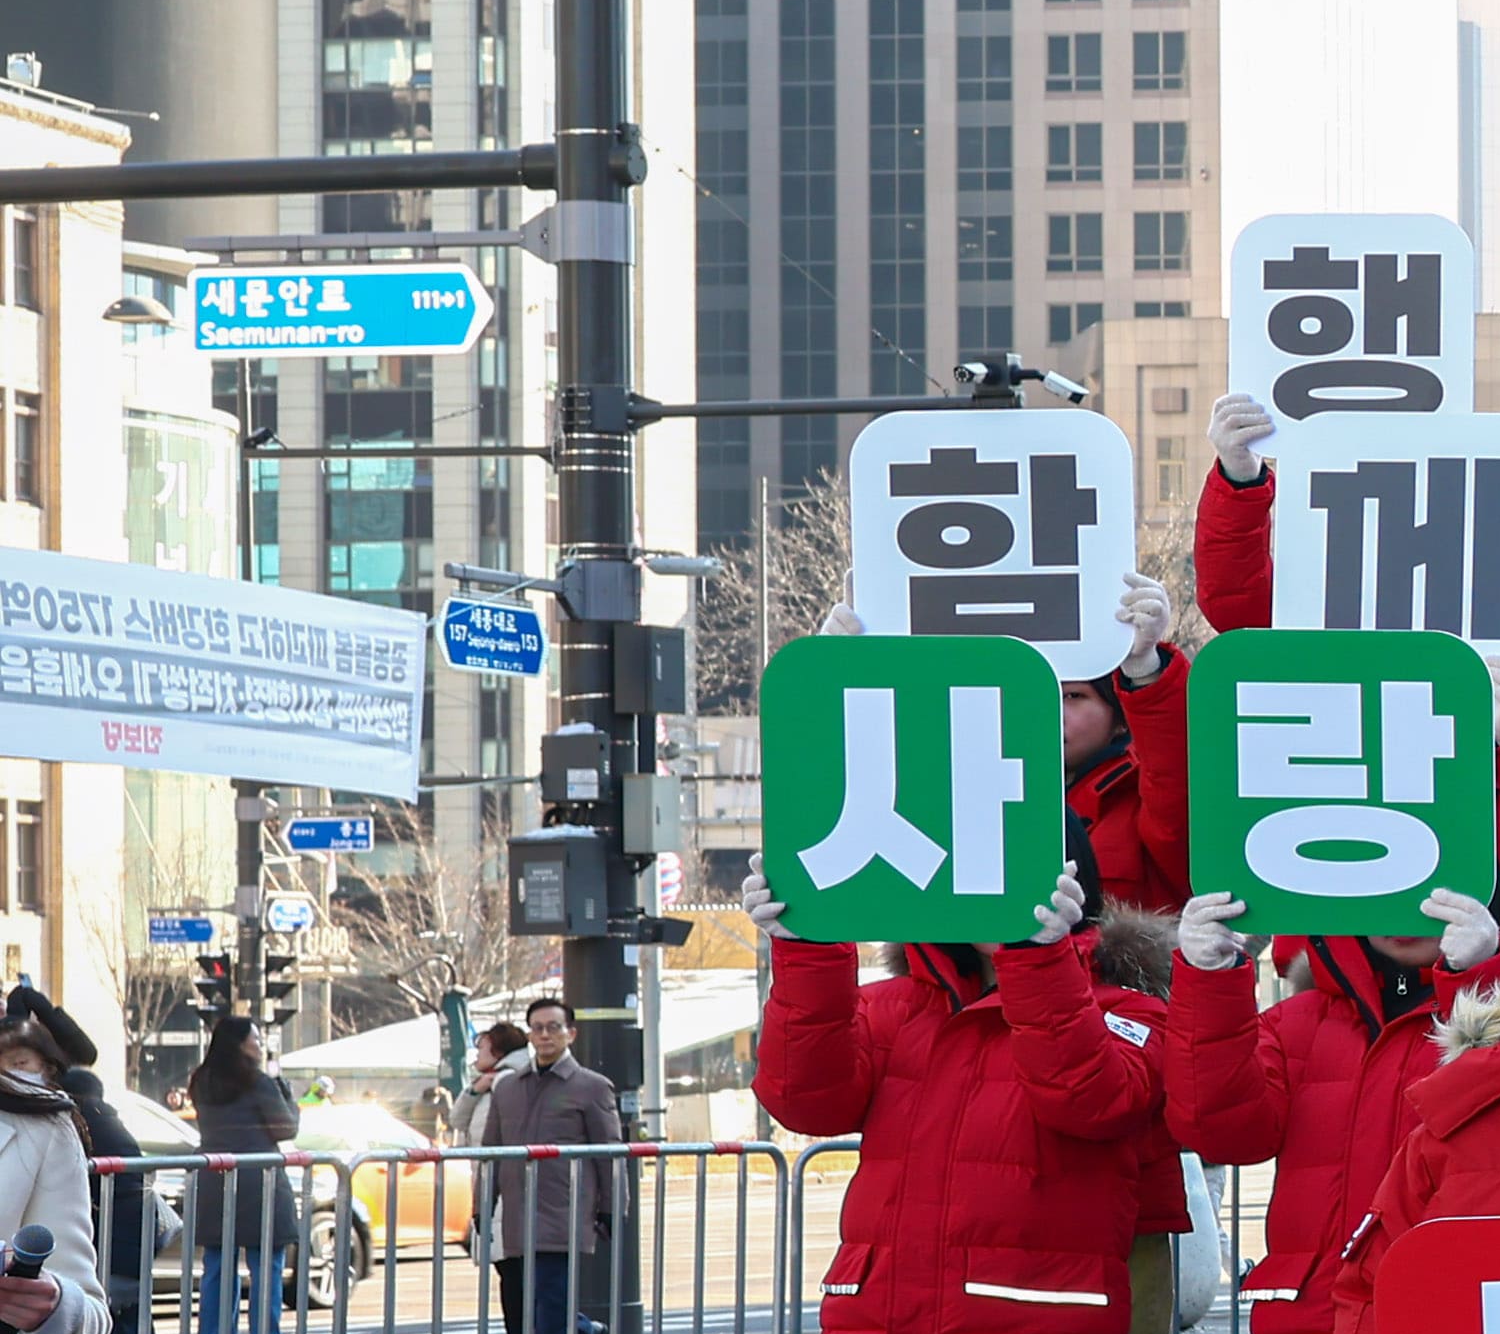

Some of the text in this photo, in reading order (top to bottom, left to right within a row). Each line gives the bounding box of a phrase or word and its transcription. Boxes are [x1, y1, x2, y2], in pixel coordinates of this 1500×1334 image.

[201, 278, 352, 318] 새문안로
[200, 321, 365, 347] Saemunan-ro
[1264, 247, 1443, 421] 행
[889, 447, 1098, 642] 함
[449, 623, 468, 642] 157
[521, 633, 539, 652] 153
[470, 608, 517, 633] 세종대로
[797, 687, 1024, 895] 사
[1237, 681, 1455, 897] 랑
